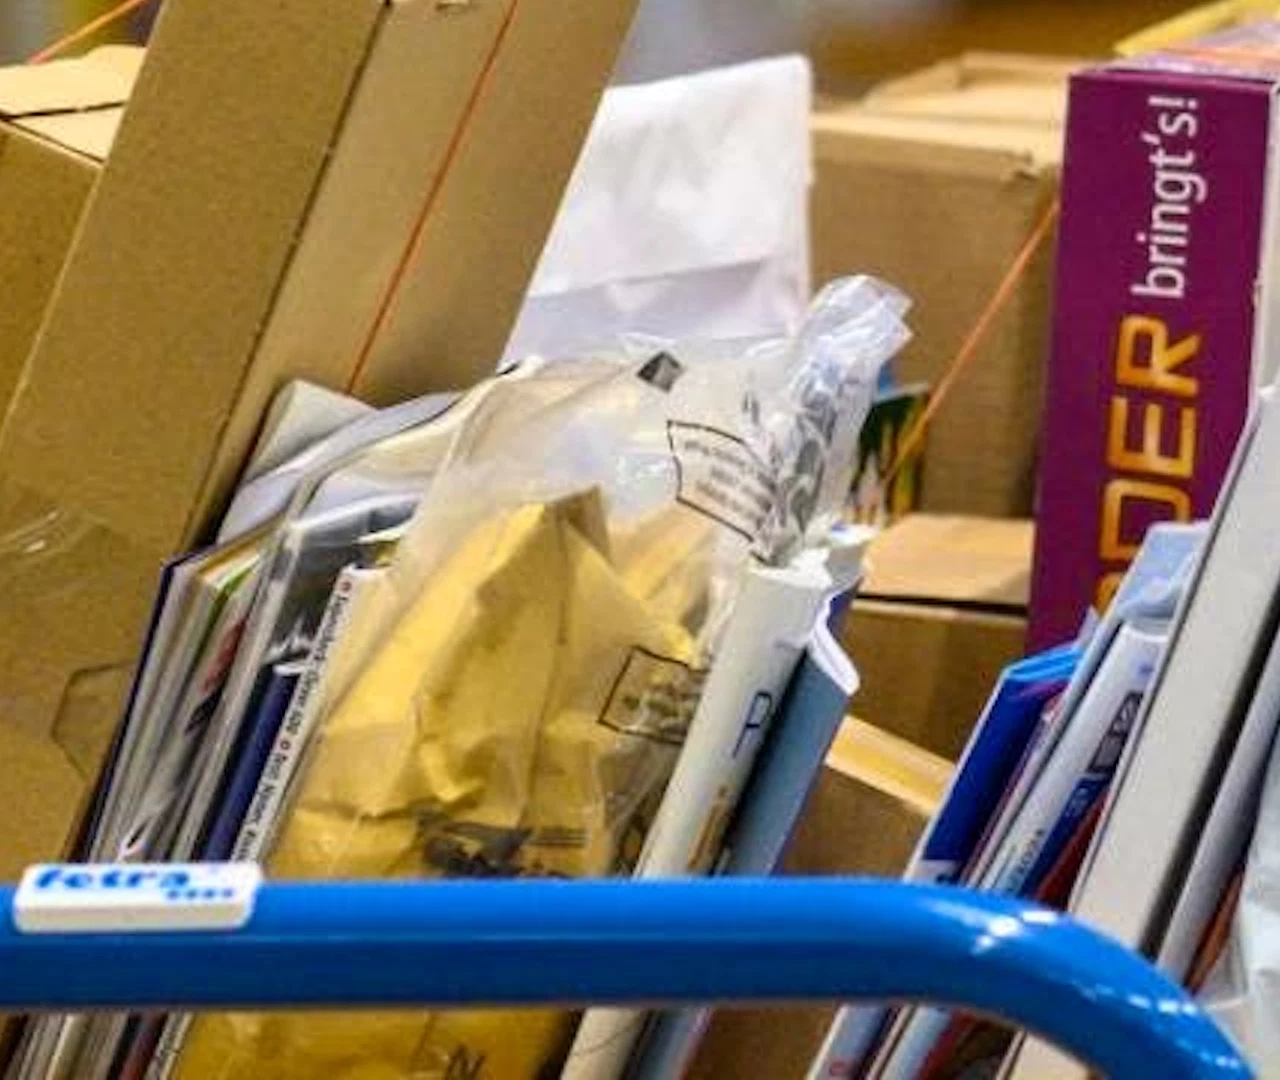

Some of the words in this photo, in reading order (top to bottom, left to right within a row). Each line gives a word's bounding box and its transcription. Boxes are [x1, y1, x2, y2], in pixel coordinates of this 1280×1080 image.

[1130, 95, 1208, 299] bringt's!
[1094, 314, 1202, 617] DER
[35, 868, 189, 889] fetra
